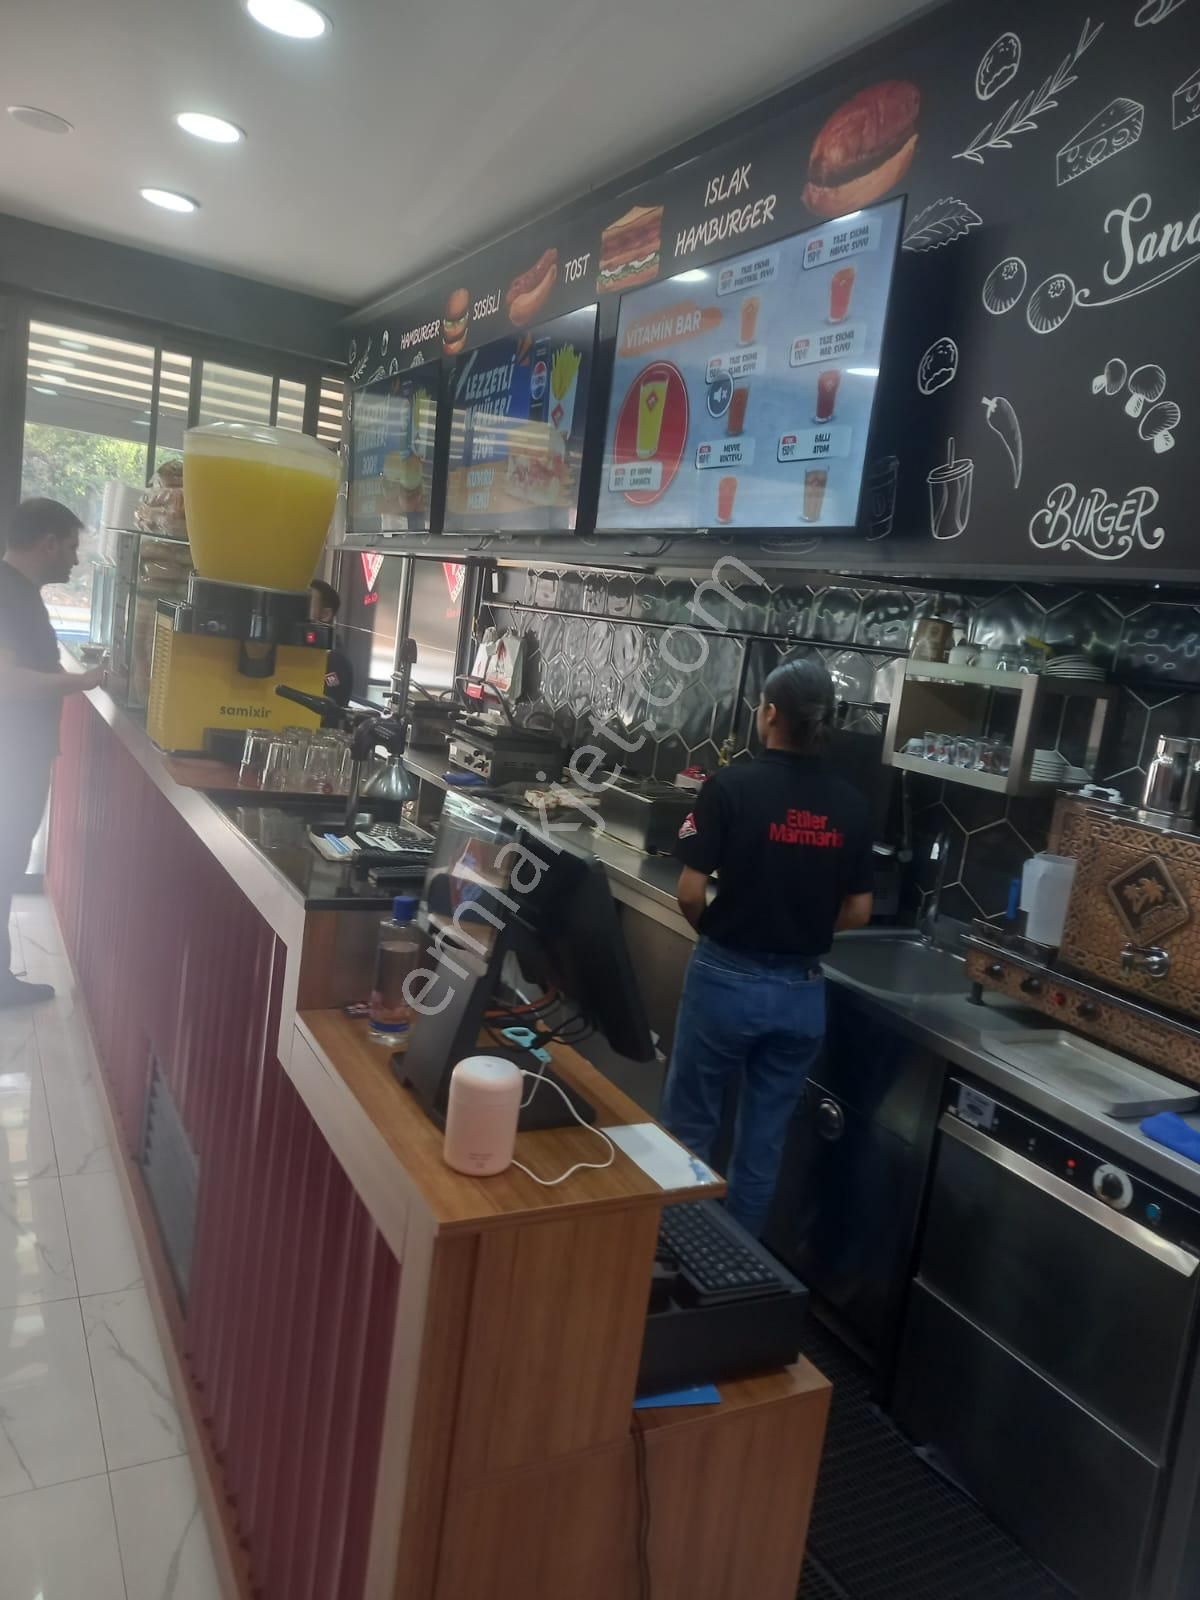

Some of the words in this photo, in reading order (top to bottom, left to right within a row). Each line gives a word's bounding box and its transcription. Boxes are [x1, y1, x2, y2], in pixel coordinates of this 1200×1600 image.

[704, 163, 751, 207] ISLAK
[674, 194, 776, 257] HAMBURGER
[564, 253, 591, 284] TOST
[400, 319, 441, 351] HAMBURGER
[675, 310, 702, 336] BAR
[465, 353, 516, 400] LEZZETLİ
[1029, 482, 1165, 551] BURGER
[219, 705, 272, 719] samixir
